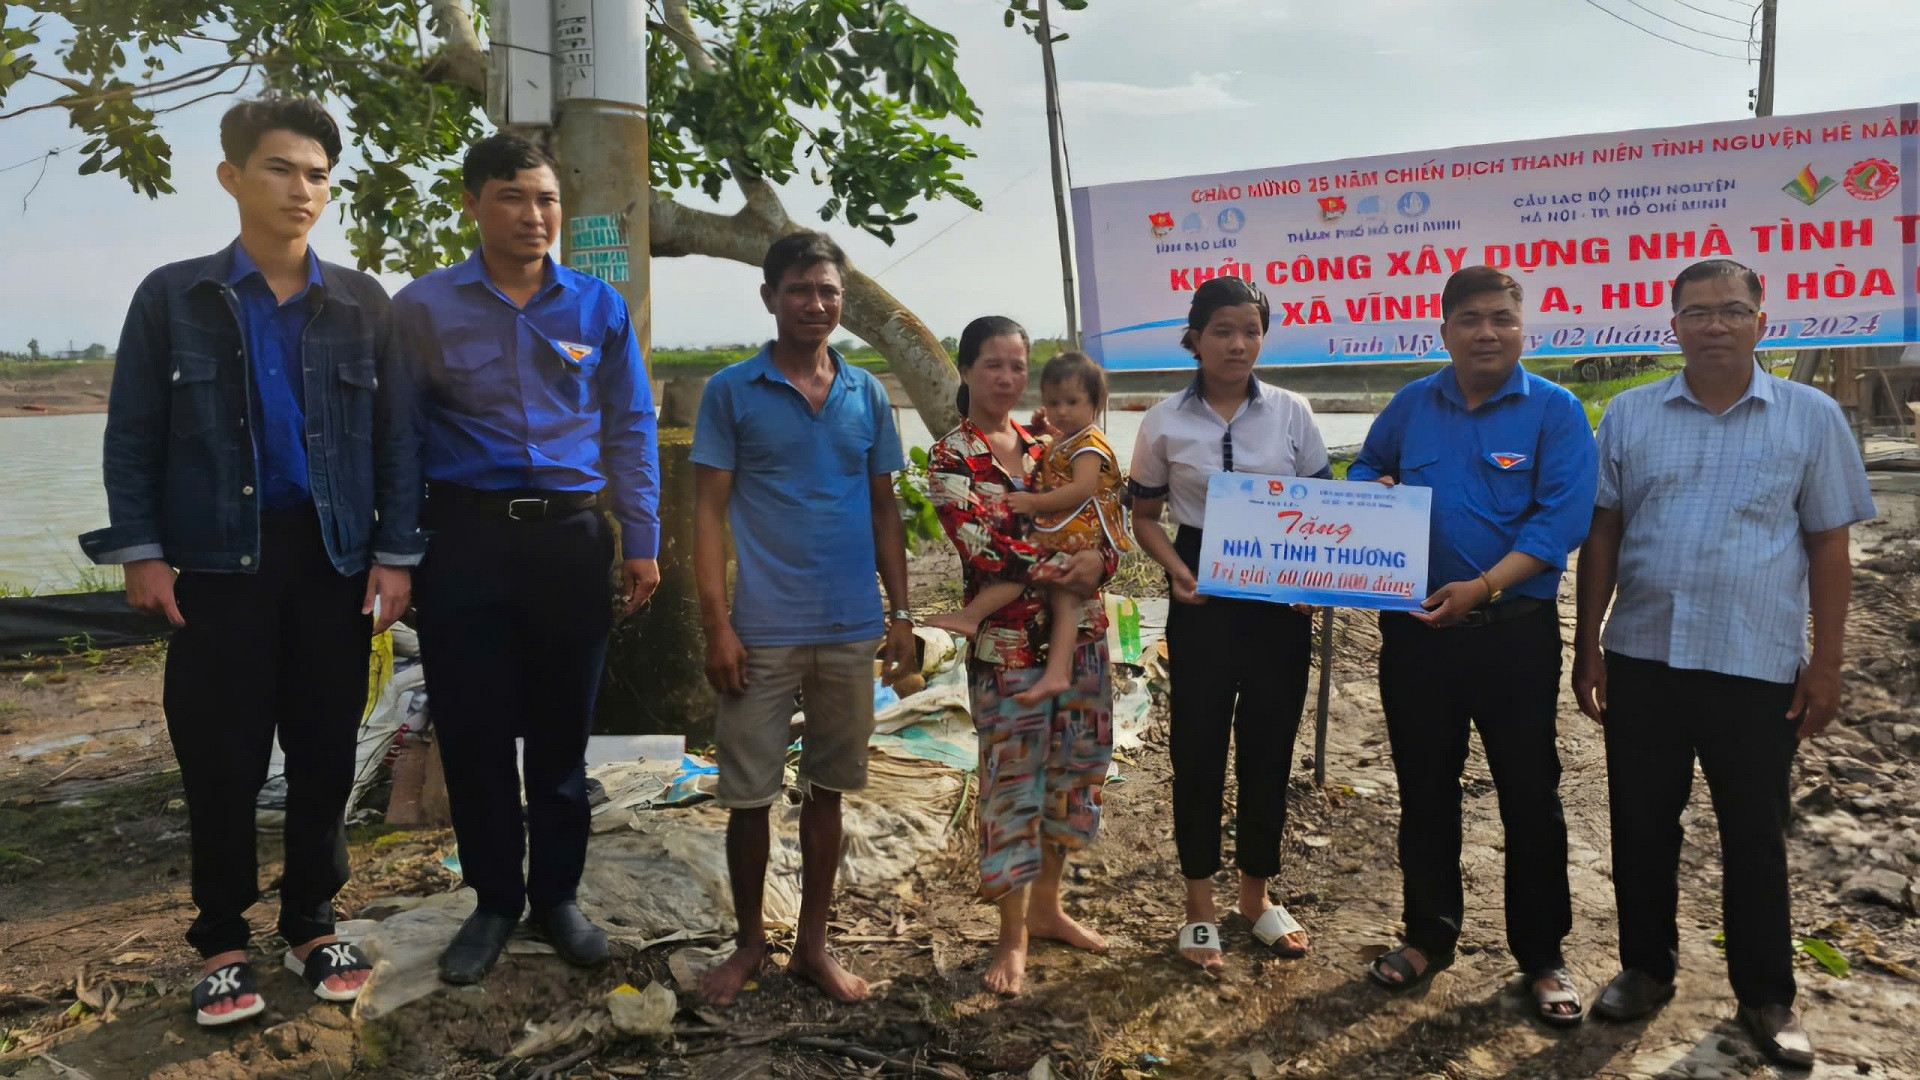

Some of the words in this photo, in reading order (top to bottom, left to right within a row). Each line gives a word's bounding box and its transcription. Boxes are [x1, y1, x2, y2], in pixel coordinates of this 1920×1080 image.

[1191, 184, 1242, 203] CHÀO
[1308, 177, 1330, 192] 25
[1335, 171, 1378, 189] NĂM
[1385, 159, 1444, 183] CHIẾN
[1452, 158, 1504, 180] DỊCH
[1511, 151, 1584, 170] THANH
[1592, 142, 1643, 164] NIÊN
[1652, 139, 1704, 157] TÌNH
[1713, 127, 1812, 152] NGUYỆN
[1862, 117, 1920, 139] NĂM
[1265, 254, 1372, 285] CÔNG
[1386, 244, 1469, 277] XÂY
[1484, 237, 1610, 273] DỰNG
[1629, 223, 1733, 261] NHÀ
[1750, 217, 1873, 253] TÌNH
[1281, 295, 1333, 327] XÃ
[1345, 292, 1442, 323] VĨNH
[1539, 286, 1583, 315] A,
[1786, 263, 1896, 300] HÒA
[1328, 335, 1383, 355] Vĩnh
[1396, 333, 1434, 357] Mỹ
[1552, 326, 1585, 347] 02
[1801, 314, 1881, 337] 2024
[1277, 510, 1353, 544] Tặng
[1222, 536, 1262, 559] NHÀ
[1270, 539, 1316, 563] TÌNH
[1193, 925, 1209, 945] G
